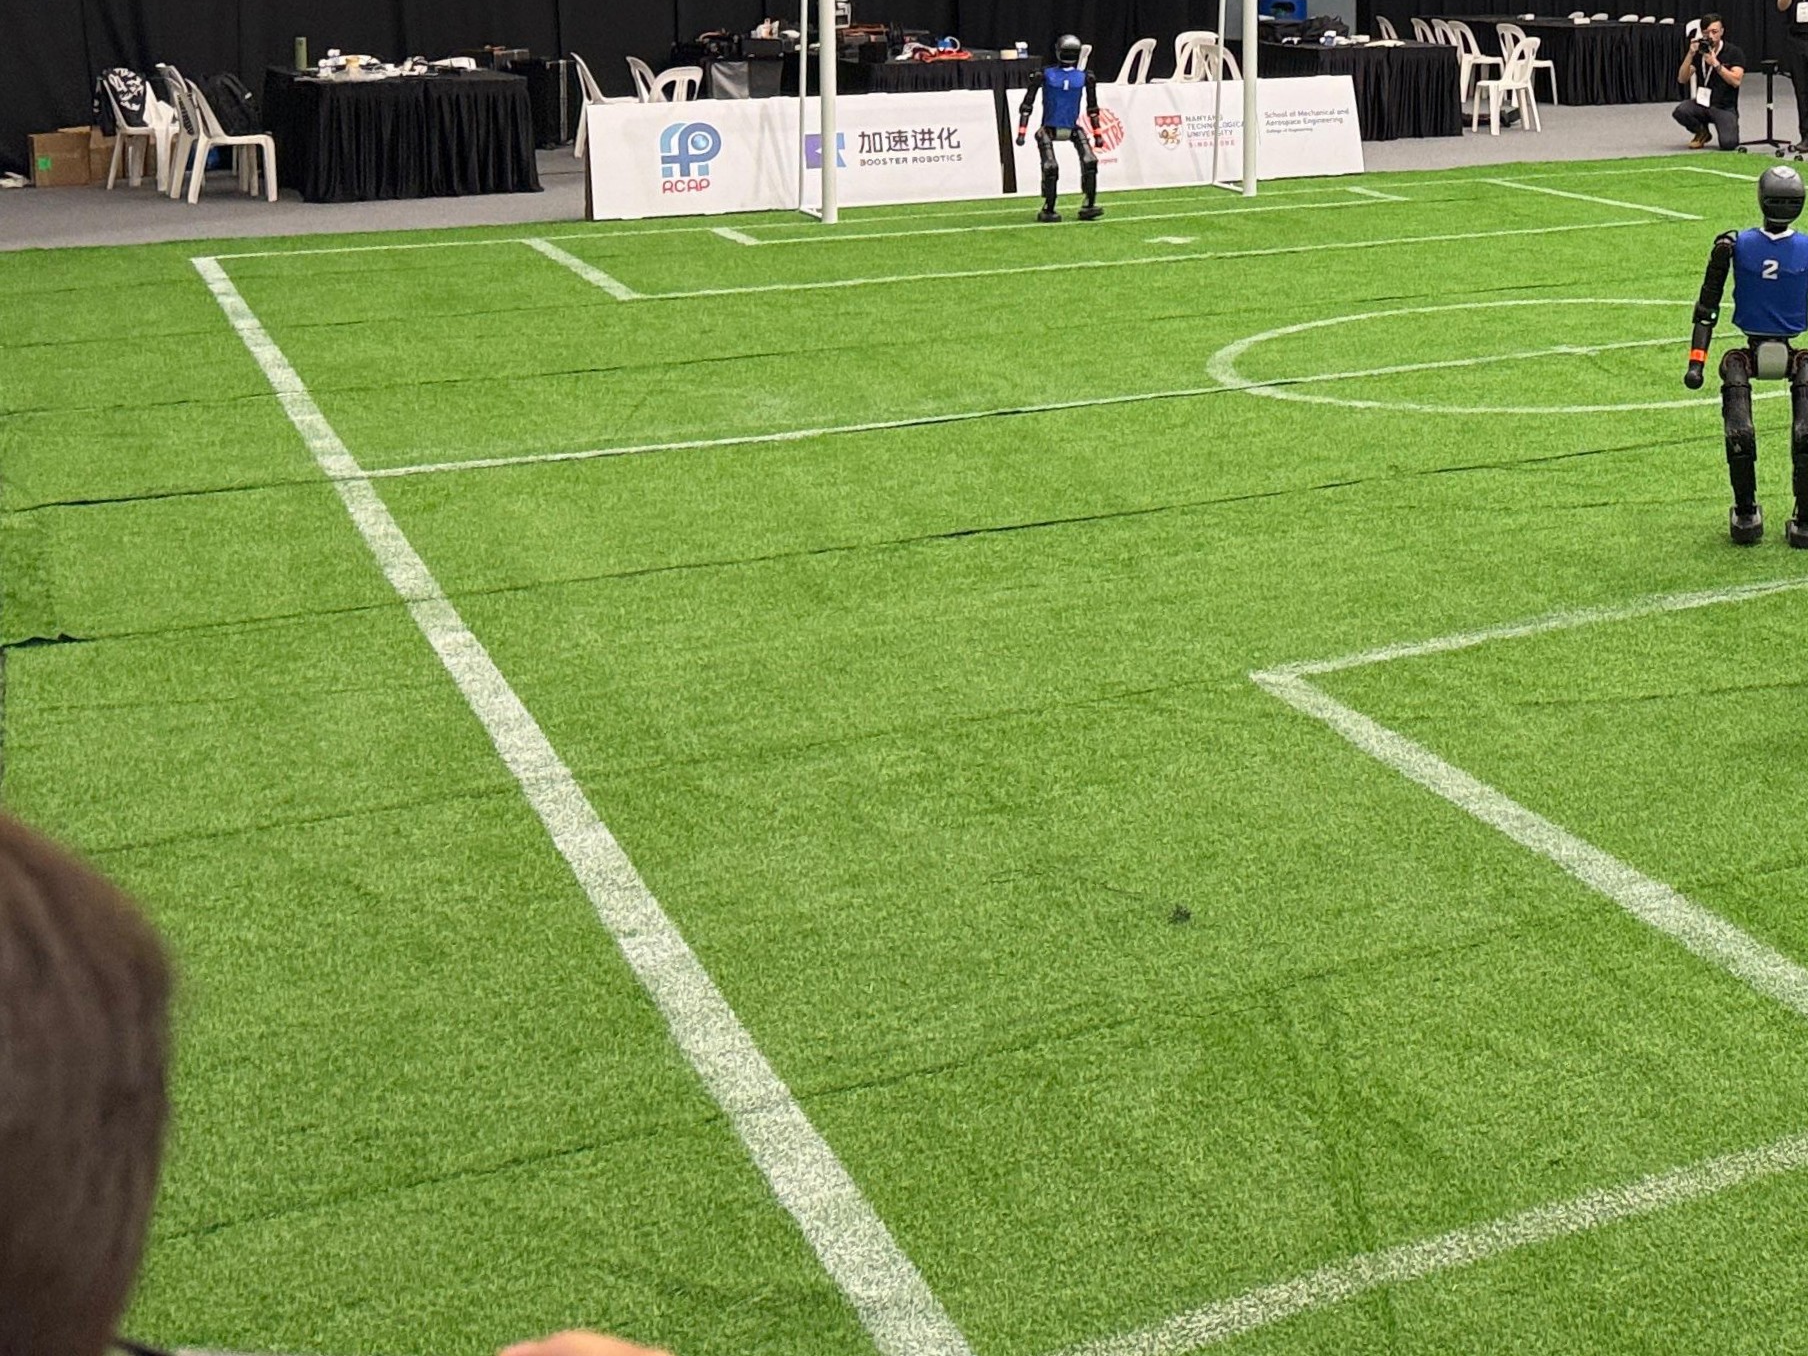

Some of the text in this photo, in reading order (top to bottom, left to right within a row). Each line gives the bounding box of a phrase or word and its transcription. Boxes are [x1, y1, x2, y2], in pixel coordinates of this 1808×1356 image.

[1063, 79, 1070, 91] 1
[858, 127, 961, 154] 加速进化
[860, 154, 962, 167] BOOSTER ROBOTICS
[1762, 259, 1779, 280] 2
